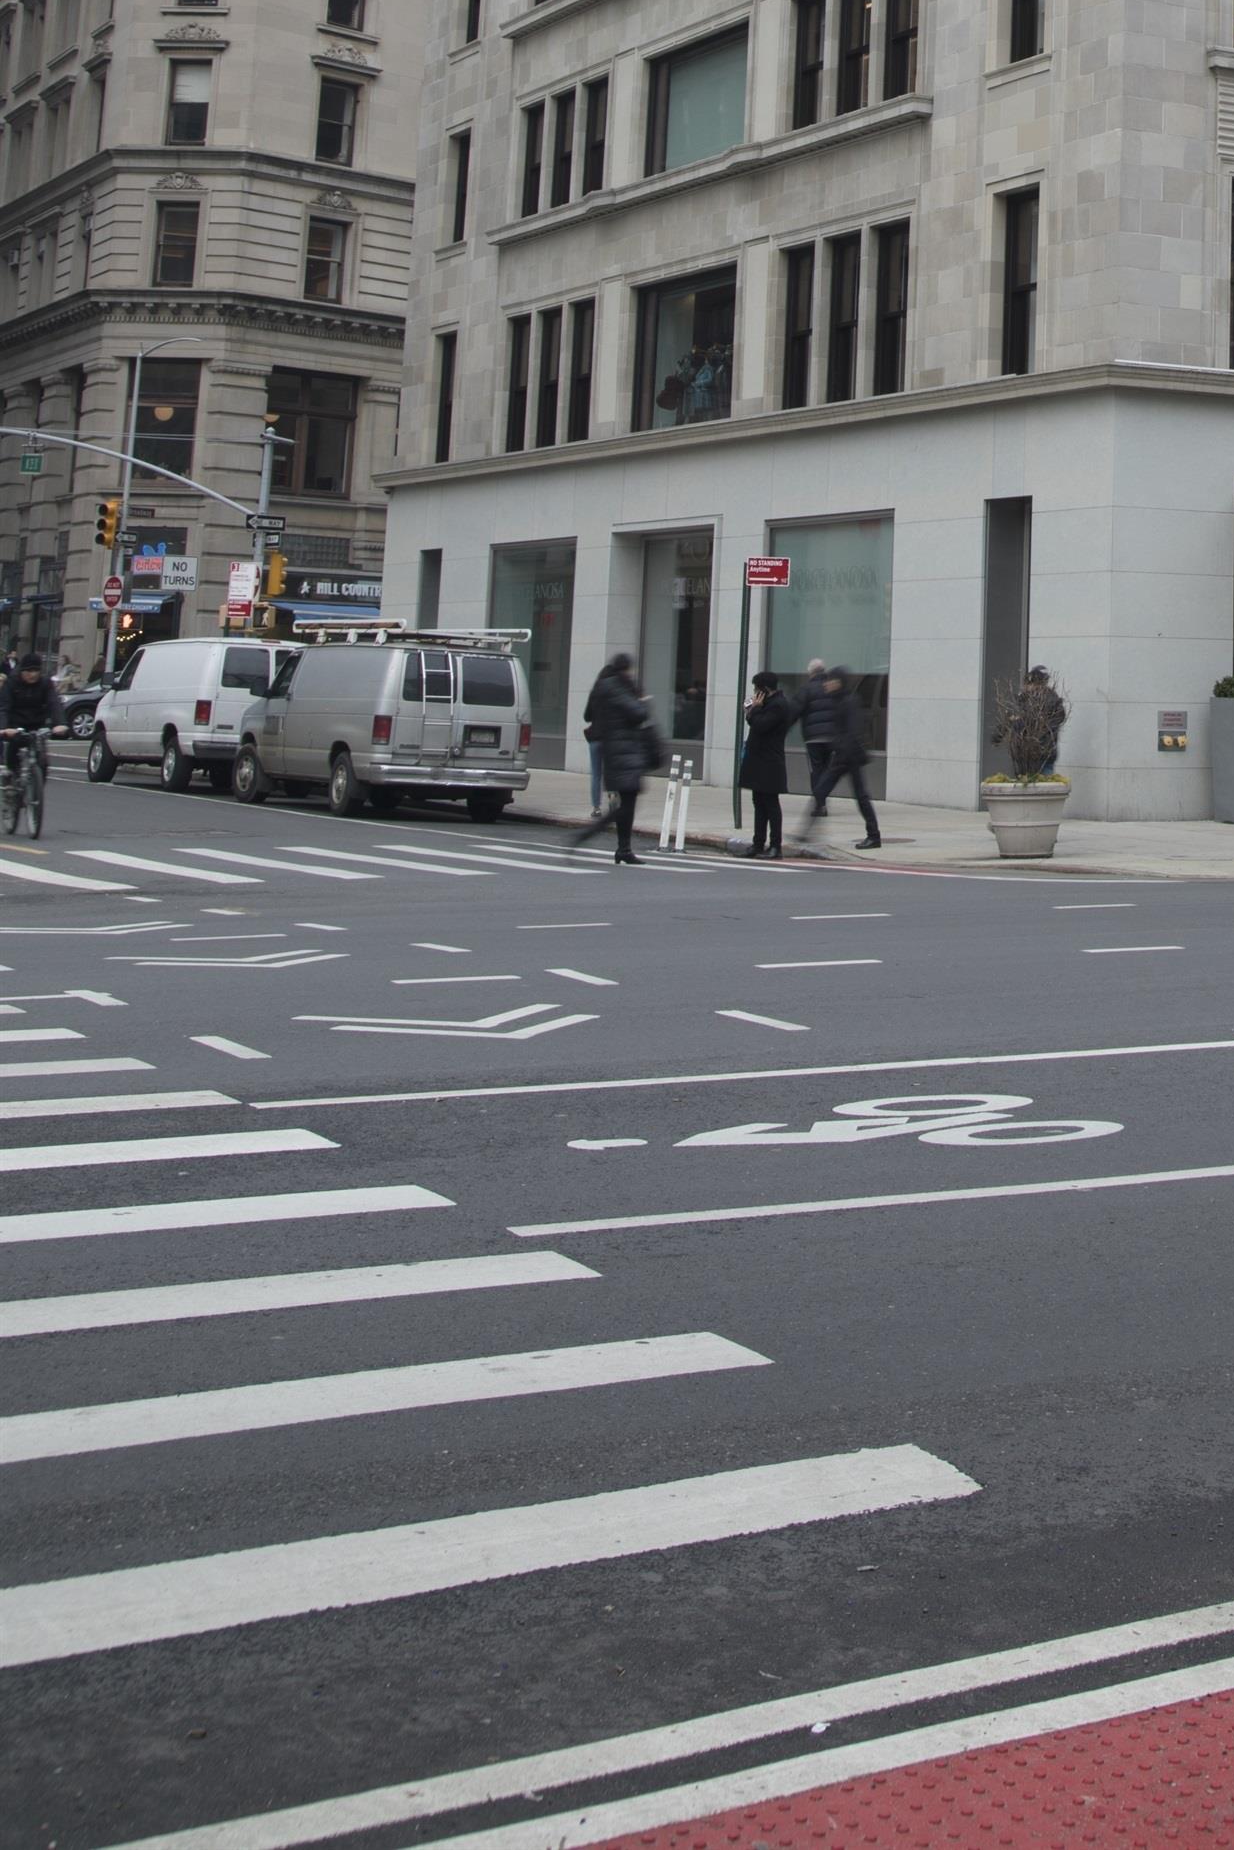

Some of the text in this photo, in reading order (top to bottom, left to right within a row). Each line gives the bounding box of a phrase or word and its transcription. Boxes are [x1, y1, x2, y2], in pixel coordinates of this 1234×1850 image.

[172, 561, 187, 572] NO
[750, 559, 783, 567] NO STANDING
[163, 576, 195, 586] TURNS
[316, 582, 340, 595] HILL
